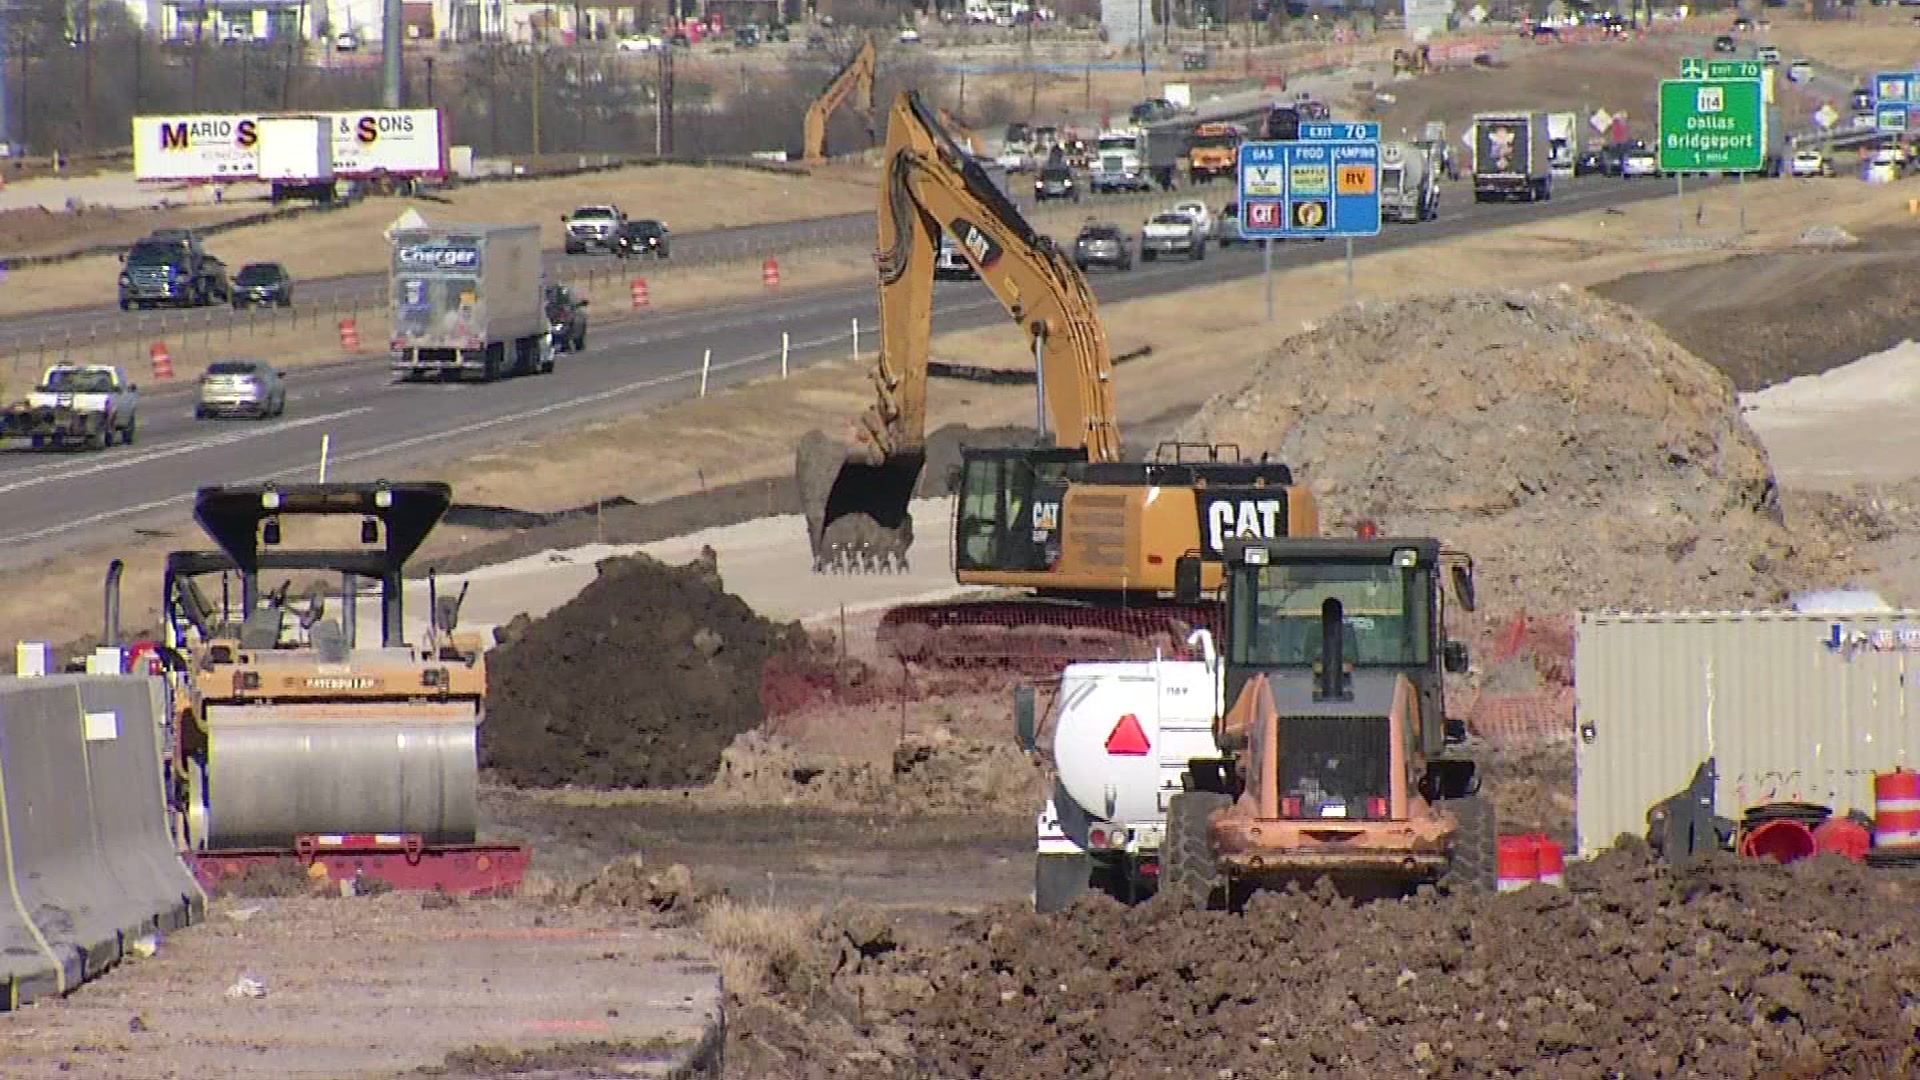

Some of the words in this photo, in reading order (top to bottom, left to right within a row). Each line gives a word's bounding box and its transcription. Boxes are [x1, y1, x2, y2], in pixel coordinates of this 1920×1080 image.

[1741, 64, 1758, 76] 70
[1701, 96, 1720, 110] 114
[340, 120, 350, 133] &
[357, 114, 414, 143] SONS
[1687, 117, 1735, 130] Dallas
[161, 119, 231, 149] MARIO
[1309, 127, 1332, 137] EXIT
[1345, 125, 1366, 139] 70
[1667, 134, 1753, 151] Bridgeport
[1252, 149, 1274, 160] GAS
[1295, 148, 1324, 159] FOOD
[1345, 173, 1366, 185] RV
[965, 226, 990, 262] CAT
[1032, 501, 1059, 529] CAT
[1208, 500, 1280, 551] CAT
